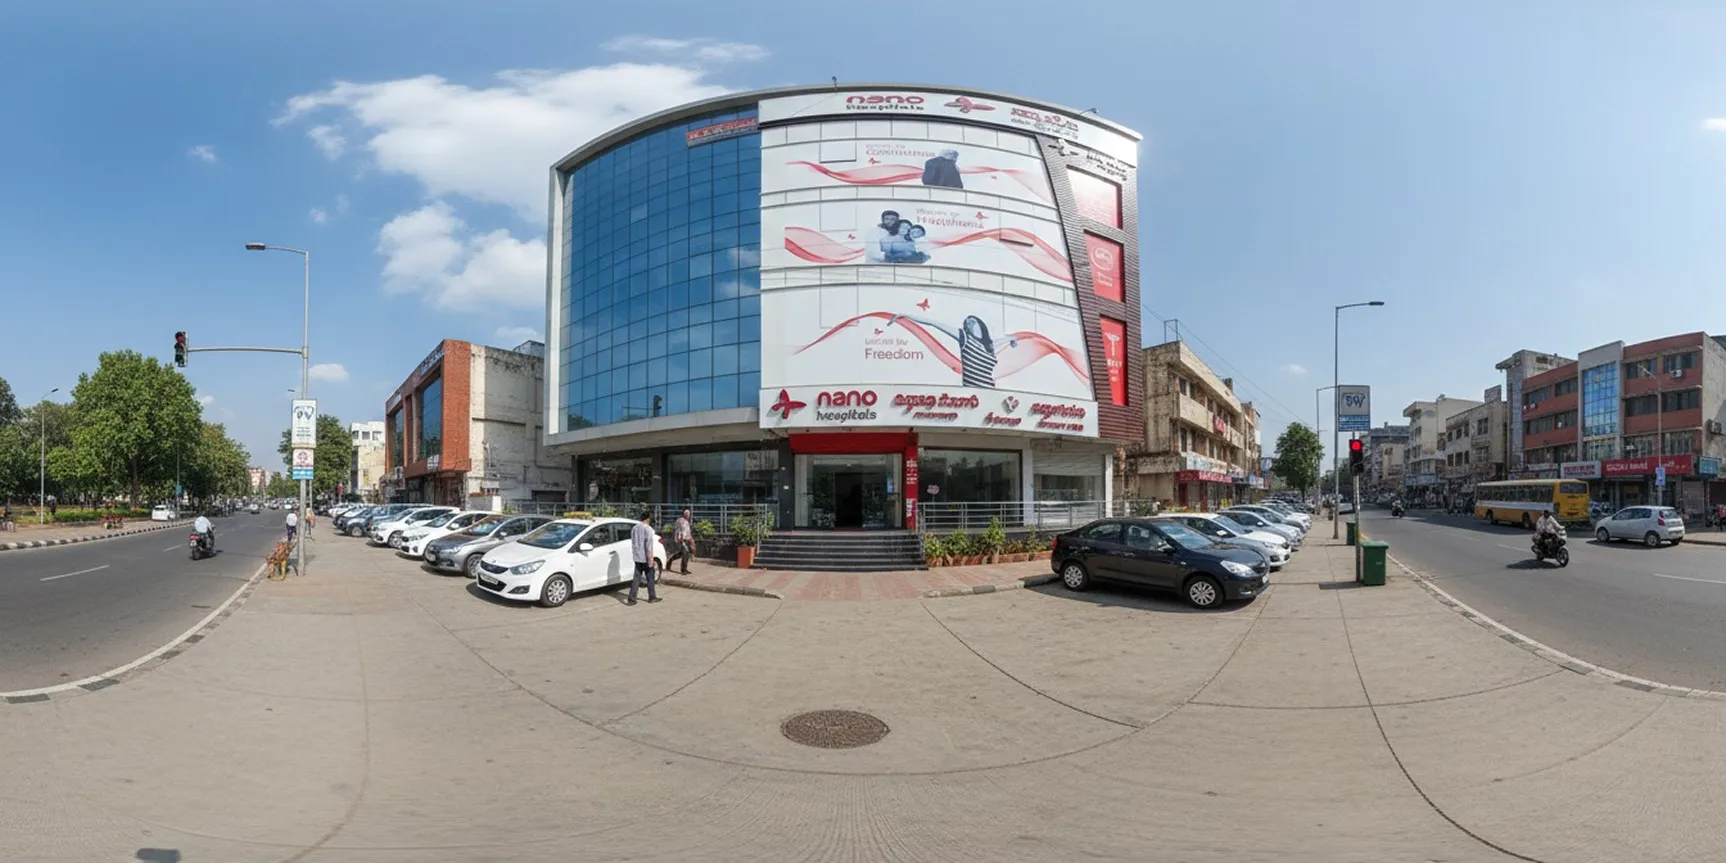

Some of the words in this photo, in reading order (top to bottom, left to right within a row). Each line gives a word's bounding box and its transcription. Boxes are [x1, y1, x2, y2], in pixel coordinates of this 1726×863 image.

[846, 96, 924, 104] nano
[864, 347, 924, 360] Freedom
[817, 390, 878, 407] nano
